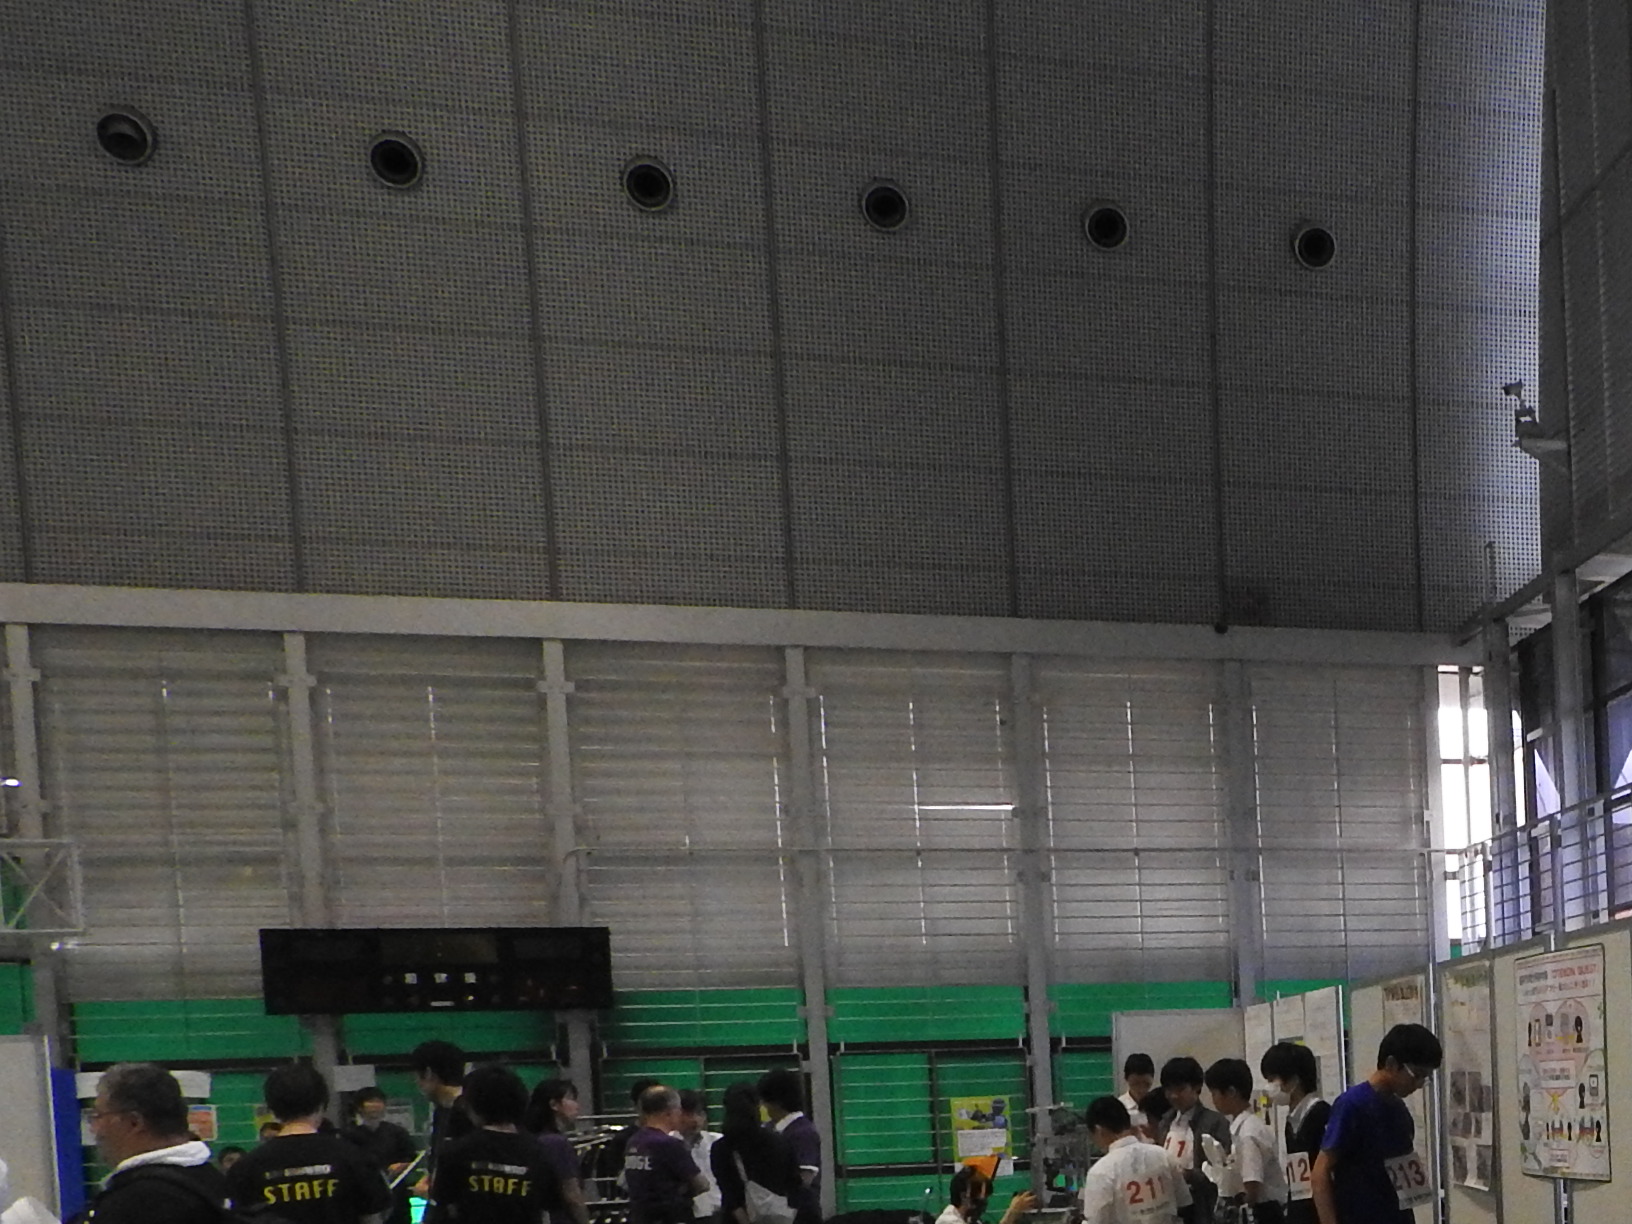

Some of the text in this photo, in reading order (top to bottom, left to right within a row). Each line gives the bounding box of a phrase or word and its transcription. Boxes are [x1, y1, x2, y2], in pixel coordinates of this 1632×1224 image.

[1287, 1158, 1311, 1184] 12
[263, 1179, 339, 1205] STAFF
[469, 1175, 533, 1197] STAFF
[1126, 1175, 1166, 1205] 211
